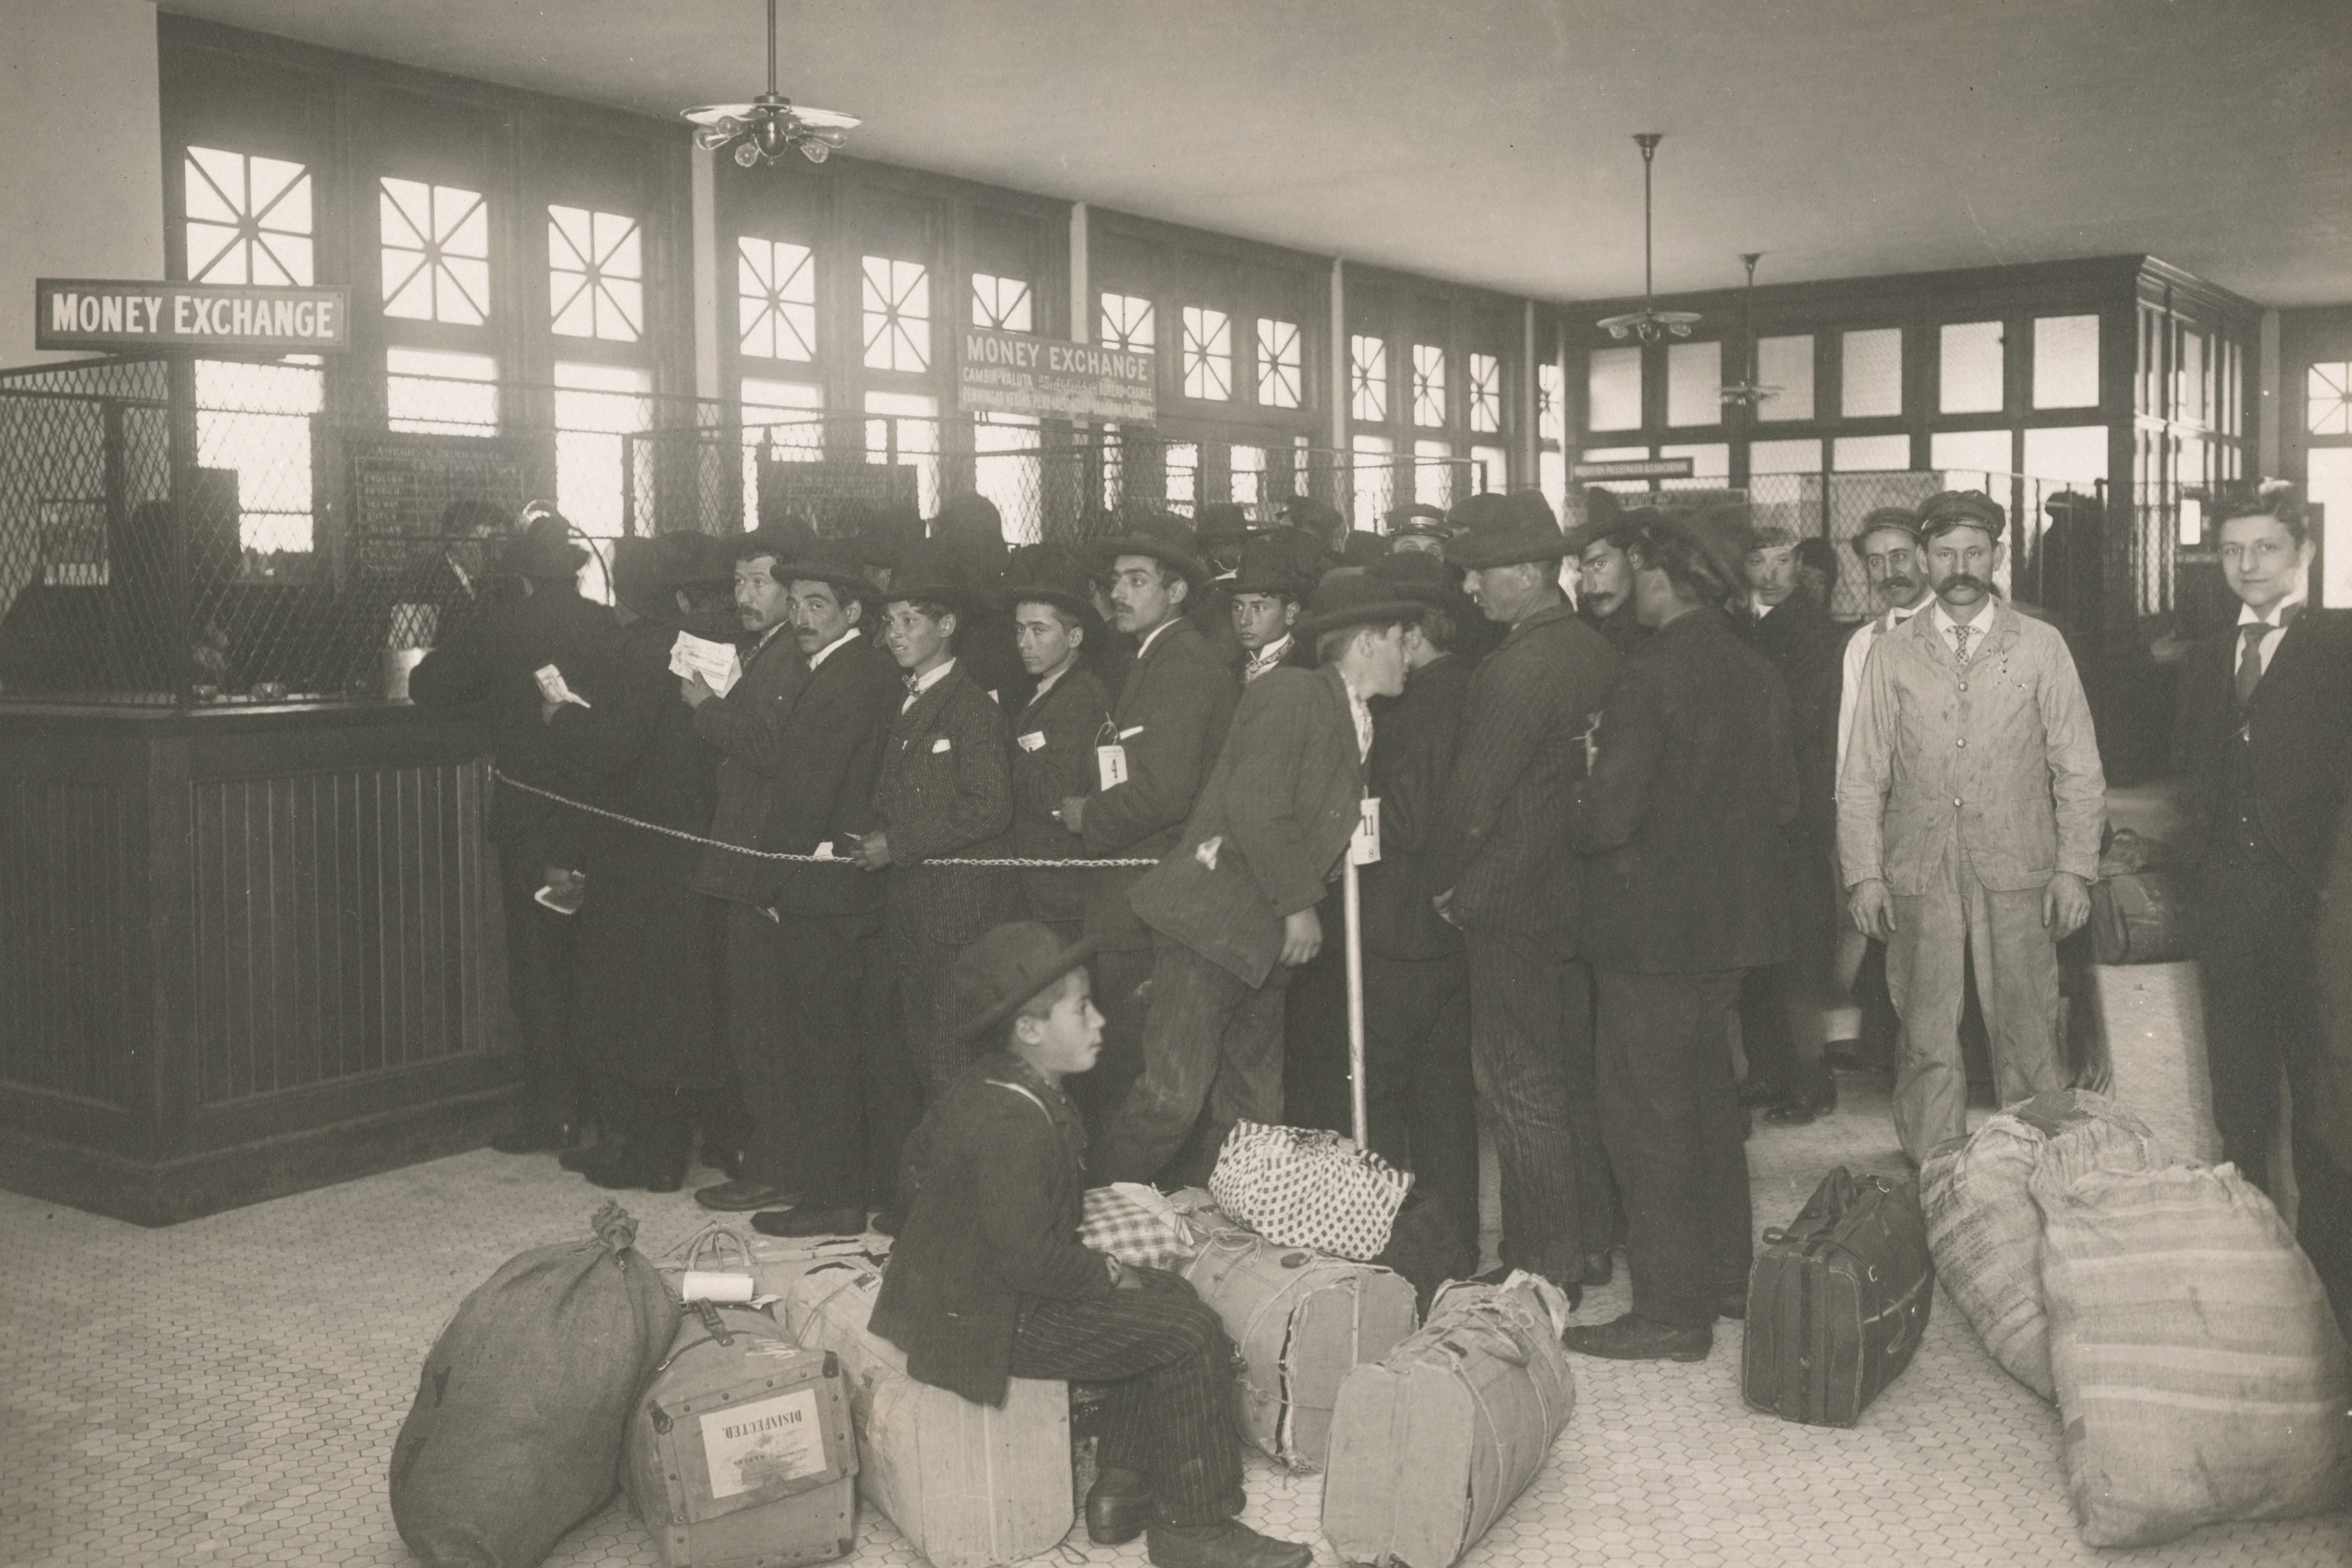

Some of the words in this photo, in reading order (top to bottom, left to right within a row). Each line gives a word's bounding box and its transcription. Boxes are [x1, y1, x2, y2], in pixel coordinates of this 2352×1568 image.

[52, 293, 163, 333] MONEY
[173, 295, 334, 338] EXCHANGE
[967, 335, 1040, 367] MONEY
[1049, 346, 1148, 381] EXCHANGE
[1110, 759, 1118, 779] 4
[1360, 814, 1374, 836] 11
[722, 1409, 802, 1439] DISINFECTED.
